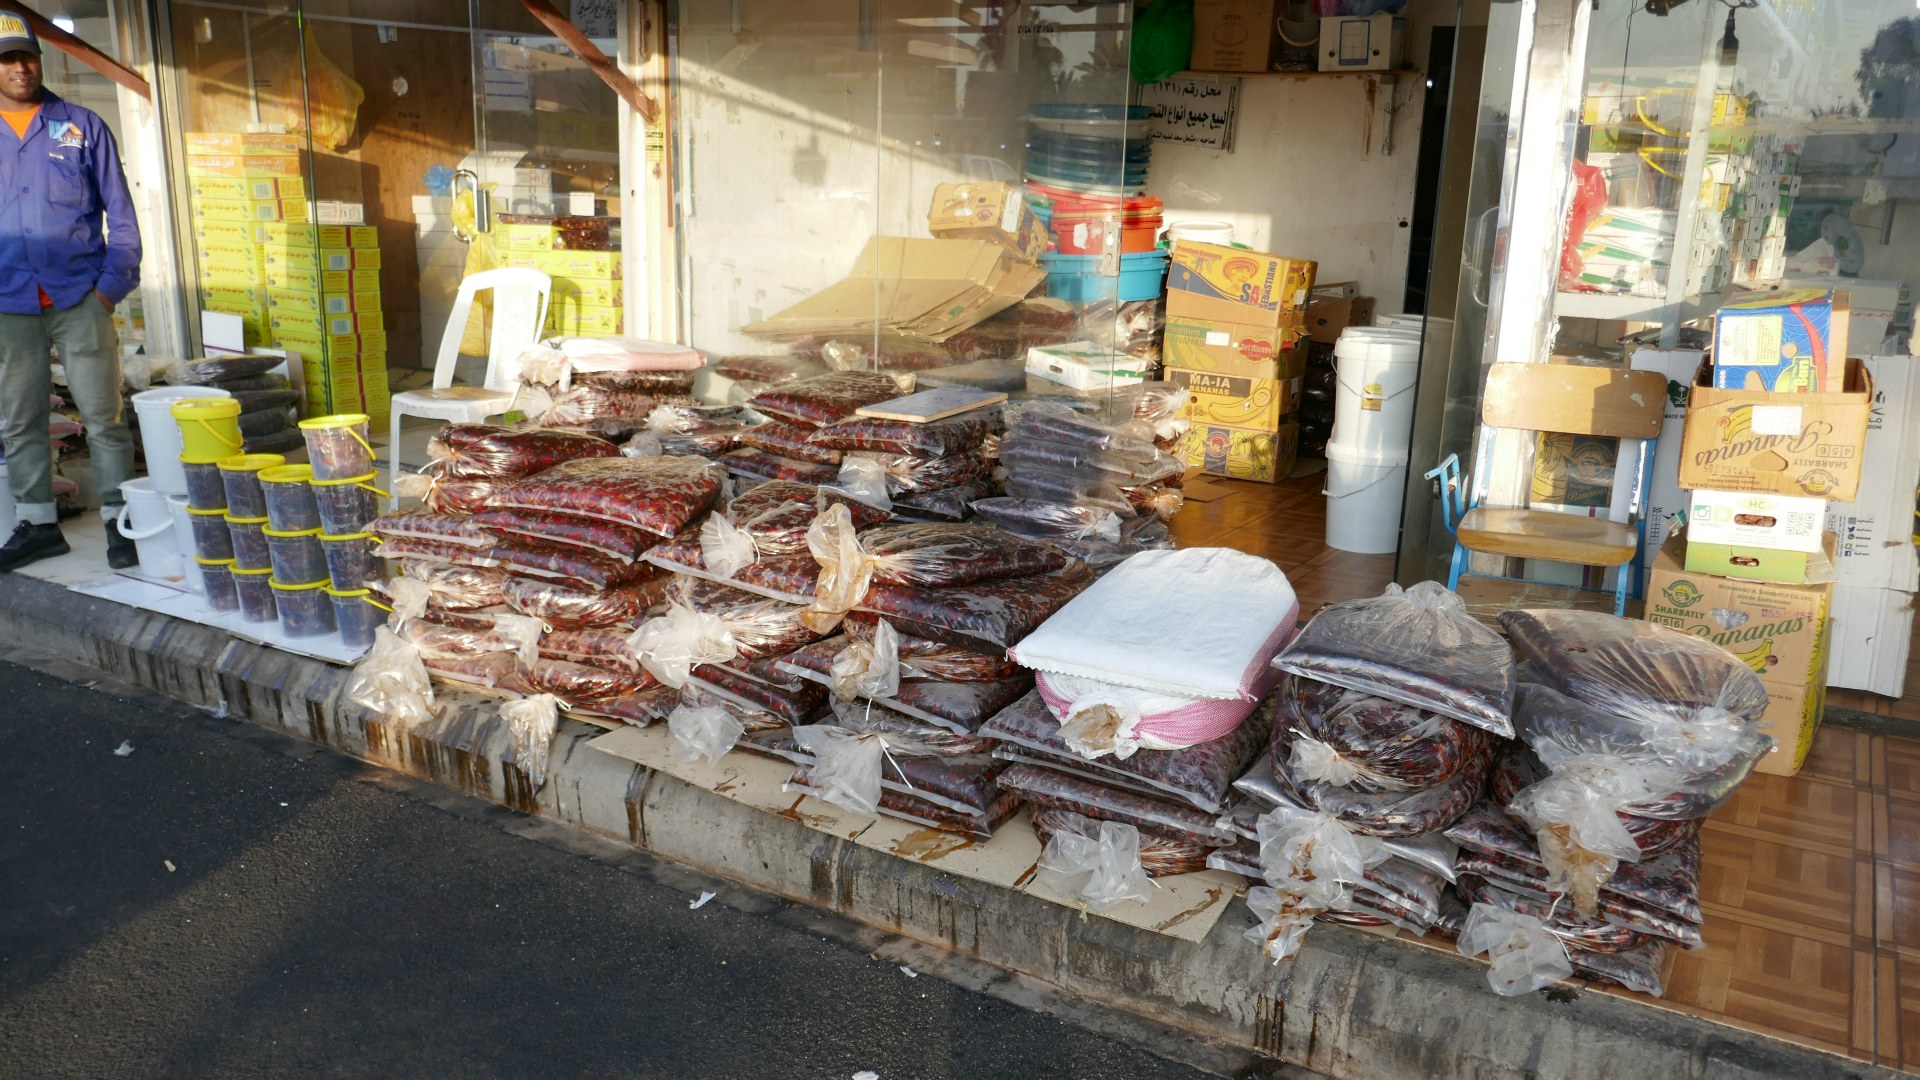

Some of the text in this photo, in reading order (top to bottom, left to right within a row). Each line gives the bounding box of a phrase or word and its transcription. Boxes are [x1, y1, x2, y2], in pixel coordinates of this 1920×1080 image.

[1182, 82, 1198, 96] رقم
[1200, 84, 1221, 98] محل
[1168, 102, 1186, 124] أنواع
[1187, 110, 1208, 127] جميع
[1210, 110, 1226, 129] لبيع
[1260, 261, 1278, 309] SEBASTIANO
[1166, 324, 1201, 336] Premium
[1165, 334, 1205, 346] BANANAS
[1251, 344, 1272, 354] Monte
[1190, 374, 1231, 388] MA-IA
[1190, 385, 1230, 396] BANANAS
[1695, 420, 1832, 466] Bananas
[1792, 458, 1848, 470] SHARBATLY
[1718, 584, 1751, 594] MOHAMMED
[1758, 590, 1790, 599] SHARBATLY
[1654, 604, 1705, 619] SHARBATLY
